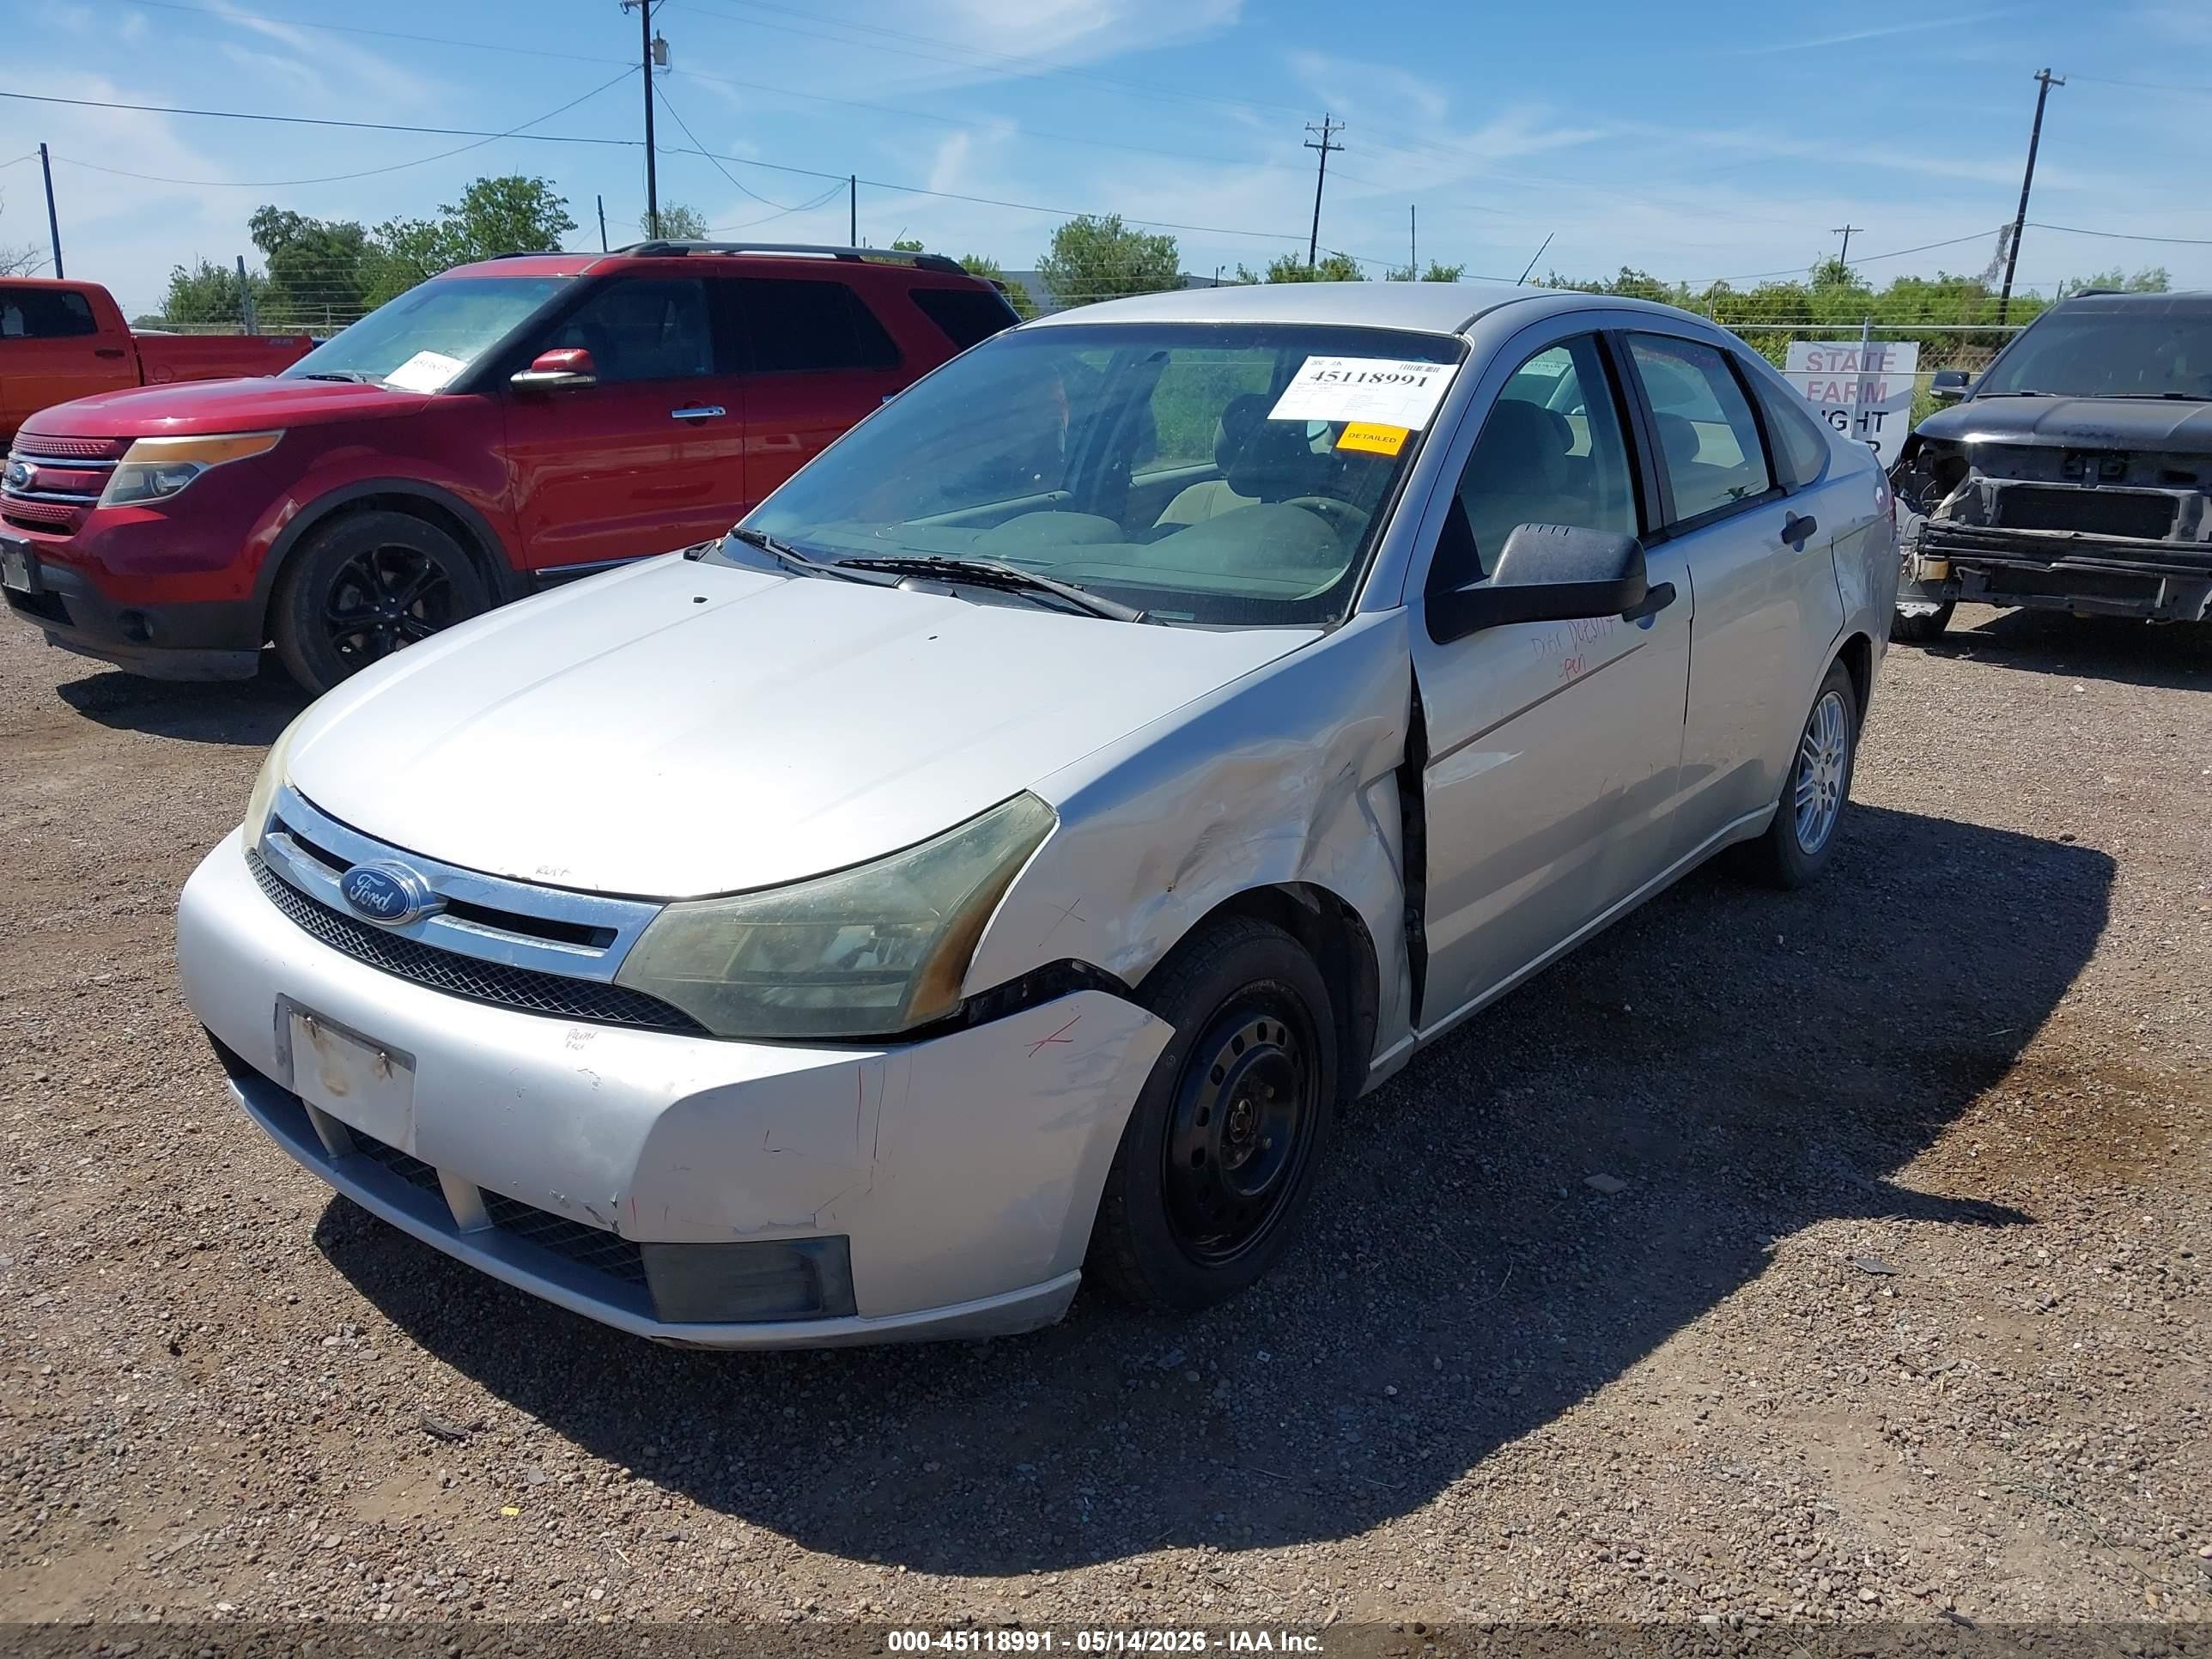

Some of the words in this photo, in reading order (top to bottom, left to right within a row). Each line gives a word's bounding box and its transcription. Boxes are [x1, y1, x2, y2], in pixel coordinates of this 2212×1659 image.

[1805, 350, 1897, 373] STATE
[1310, 369, 1429, 388] 45118991
[1806, 380, 1888, 405] FARM
[1347, 431, 1397, 445] DETAILED
[349, 873, 394, 912] Ford
